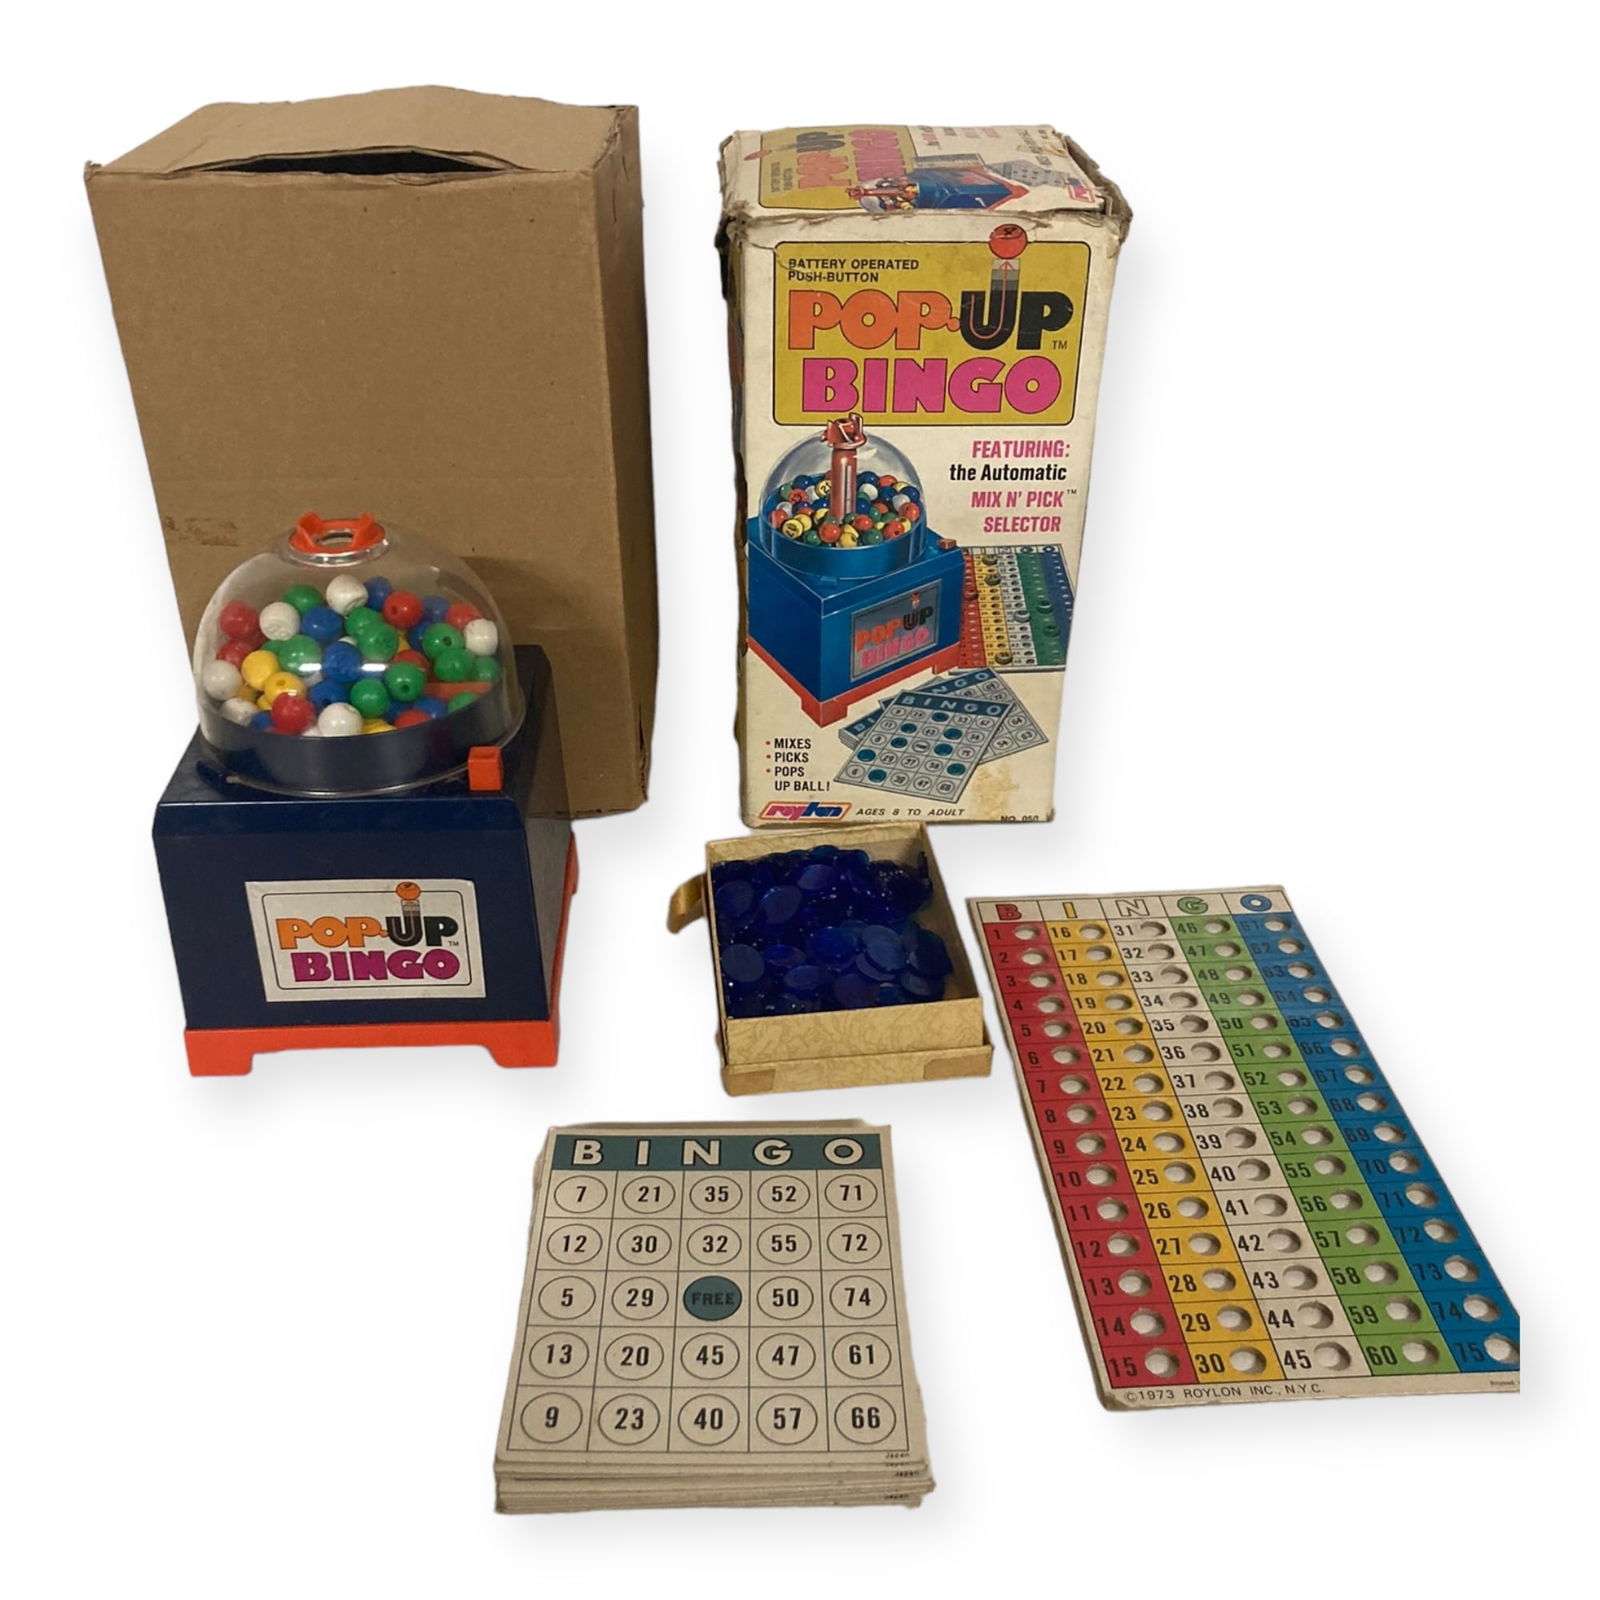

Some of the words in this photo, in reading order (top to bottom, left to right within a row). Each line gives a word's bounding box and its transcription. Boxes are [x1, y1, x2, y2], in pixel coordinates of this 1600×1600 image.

[788, 259, 846, 271] BATTERY
[851, 259, 919, 270] OPERATED
[788, 271, 879, 283] PUSH-BUTTON
[1052, 341, 1067, 350] TM
[802, 355, 1061, 413] BINGO
[972, 440, 1070, 459] FEATURING:
[949, 465, 976, 481] the
[982, 465, 1066, 482] Automatic
[972, 492, 1001, 508] MIX
[1005, 492, 1021, 508] N'
[1026, 492, 1063, 507] PICK
[983, 516, 1061, 532] SELECTOR
[774, 738, 811, 749] MIXES
[774, 751, 809, 763] PICKS
[774, 766, 804, 777] POPS
[775, 780, 791, 791] UP
[794, 779, 830, 792] BALL!
[856, 808, 885, 816] AGES
[893, 808, 900, 816] 8
[996, 903, 1021, 920] B
[1065, 902, 1078, 918] I
[1116, 899, 1149, 917] N
[1177, 897, 1208, 915] G
[1240, 894, 1272, 912] O
[996, 929, 1000, 940] 1
[1052, 927, 1070, 938] 16
[1115, 924, 1134, 936] 31
[1001, 952, 1008, 963] 2
[1058, 949, 1076, 961] 17
[1122, 948, 1142, 959] 32
[1188, 945, 1207, 956] 47
[291, 949, 460, 982] BINGO
[1007, 975, 1015, 987] 3
[1066, 973, 1087, 985] 18
[1131, 971, 1153, 983] 33
[1198, 968, 1218, 980] 48
[1013, 1000, 1022, 1011] 4
[1074, 997, 1096, 1009] 19
[1141, 995, 1163, 1007] 34
[1209, 992, 1231, 1004] 49
[1022, 1024, 1031, 1036] 5
[1083, 1021, 1105, 1034] 20
[1152, 1019, 1174, 1031] 35
[1221, 1017, 1242, 1029] 50
[1028, 1052, 1039, 1064] 6
[1092, 1048, 1114, 1062] 21
[1162, 1046, 1184, 1059] 36
[1233, 1044, 1254, 1057] 51
[1037, 1081, 1045, 1093] 7
[1102, 1078, 1123, 1090] 22
[1173, 1074, 1194, 1088] 37
[1245, 1072, 1268, 1085] 52
[1045, 1109, 1056, 1123] 8
[1112, 1107, 1136, 1121] 23
[1185, 1104, 1208, 1118] 38
[1258, 1101, 1281, 1114] 53
[1053, 1140, 1065, 1154] 9
[1122, 1138, 1146, 1152] 24
[1197, 1134, 1221, 1149] 39
[1271, 1131, 1296, 1146] 54
[1057, 1171, 1080, 1187] 10
[1133, 1168, 1158, 1184] 25
[1211, 1166, 1235, 1182] 40
[1285, 1162, 1311, 1178] 55
[576, 1185, 587, 1202] 7
[638, 1187, 661, 1202] 21
[704, 1186, 729, 1201] 35
[771, 1186, 797, 1201] 52
[839, 1184, 863, 1200] 71
[1068, 1205, 1090, 1221] 11
[1144, 1203, 1170, 1219] 26
[1226, 1200, 1249, 1216] 41
[1300, 1196, 1327, 1212] 56
[563, 1235, 587, 1253] 12
[631, 1235, 658, 1253] 30
[702, 1235, 729, 1252] 32
[771, 1235, 797, 1252] 55
[841, 1234, 868, 1251] 72
[1076, 1241, 1100, 1257] 12
[1156, 1238, 1181, 1255] 27
[1238, 1235, 1264, 1252] 42
[1315, 1230, 1341, 1248] 57
[1086, 1278, 1114, 1295] 13
[1169, 1274, 1197, 1292] 28
[1252, 1271, 1279, 1289] 43
[1332, 1268, 1360, 1285] 58
[561, 1289, 573, 1306] 5
[627, 1289, 654, 1306] 29
[691, 1293, 735, 1305] FREE
[772, 1289, 799, 1307] 50
[844, 1287, 871, 1305] 74
[1097, 1317, 1125, 1336] 14
[1181, 1313, 1210, 1332] 29
[1268, 1310, 1294, 1329] 44
[1350, 1305, 1379, 1324] 59
[546, 1344, 573, 1364] 13
[620, 1346, 649, 1366] 20
[696, 1346, 724, 1365] 45
[771, 1345, 799, 1365] 47
[849, 1344, 875, 1364] 61
[1109, 1357, 1138, 1377] 15
[1197, 1354, 1224, 1373] 30
[1284, 1349, 1311, 1369] 45
[1367, 1345, 1397, 1365] 60
[1184, 1387, 1241, 1398] ROYLON
[544, 1406, 559, 1428] 9
[614, 1409, 644, 1429] 23
[693, 1408, 723, 1429] 40
[773, 1408, 801, 1429] 57
[851, 1408, 881, 1428] 66
